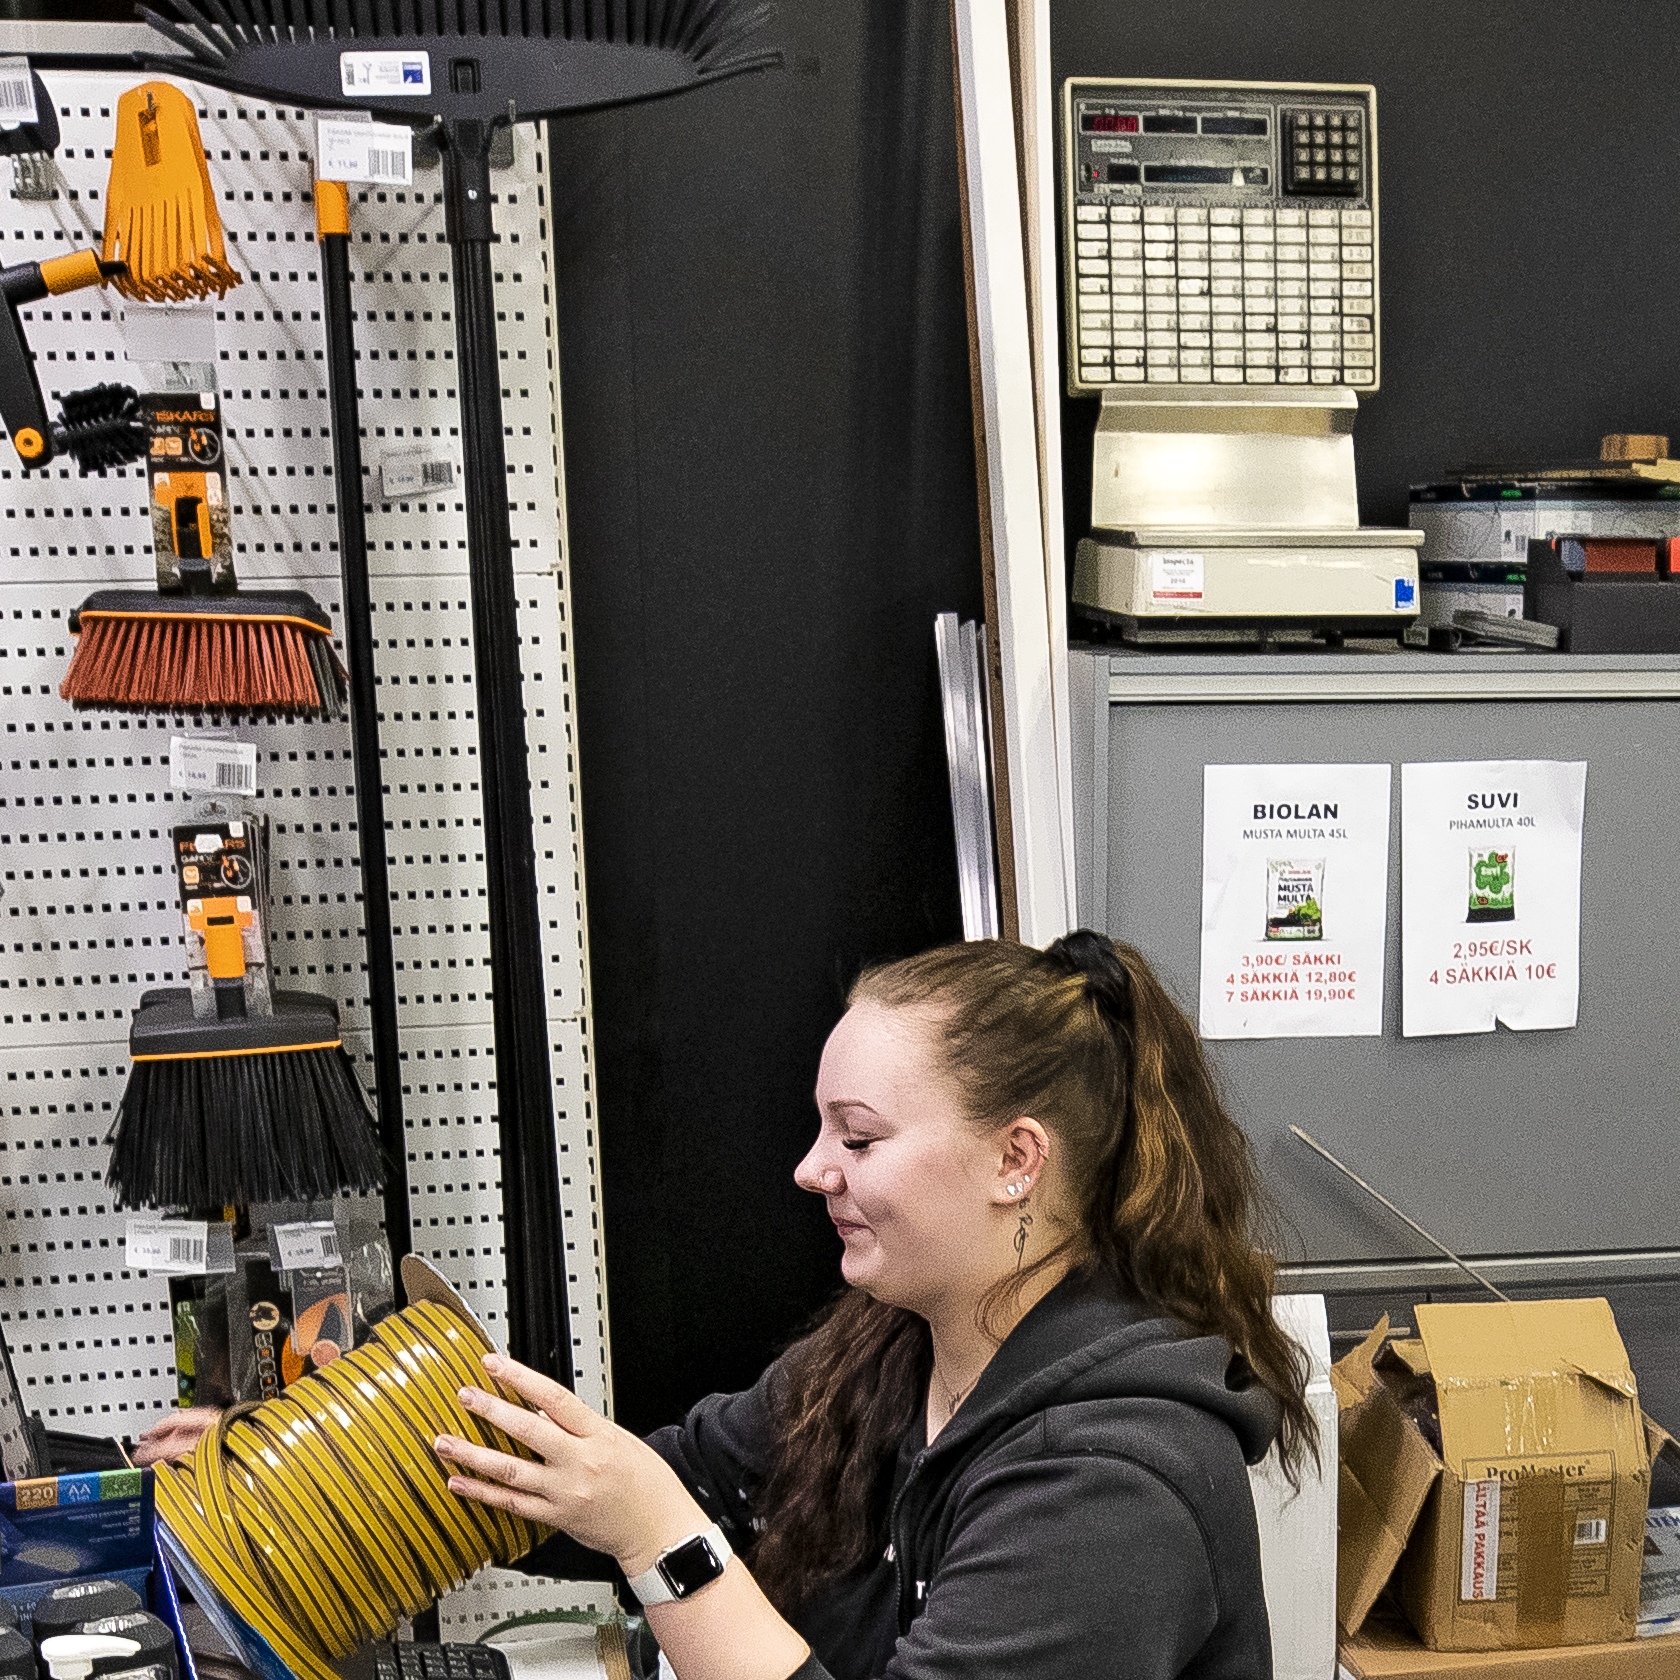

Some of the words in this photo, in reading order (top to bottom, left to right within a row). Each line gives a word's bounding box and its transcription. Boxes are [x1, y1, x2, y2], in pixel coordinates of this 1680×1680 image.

[155, 411, 215, 422] ISKARS
[1467, 792, 1519, 810] SUVI
[1252, 803, 1339, 821] BIOLAN
[1449, 817, 1513, 831] PIHAMULTA
[1517, 816, 1536, 828] 40L
[1243, 828, 1283, 840] MUSTA
[1286, 827, 1325, 840] MULTA
[1328, 827, 1348, 840] 45L
[1277, 883, 1314, 893] MUSTA
[1292, 952, 1341, 966] SÄKKI
[1226, 974, 1235, 985] 4
[1240, 969, 1300, 985] SÄKKIÄ
[1429, 970, 1439, 985] 4
[1445, 961, 1518, 985] SÄKKIÄ
[1525, 962, 1557, 980] 10€
[1226, 991, 1234, 1002] 7
[1240, 986, 1300, 1002] SÄKKIÄ
